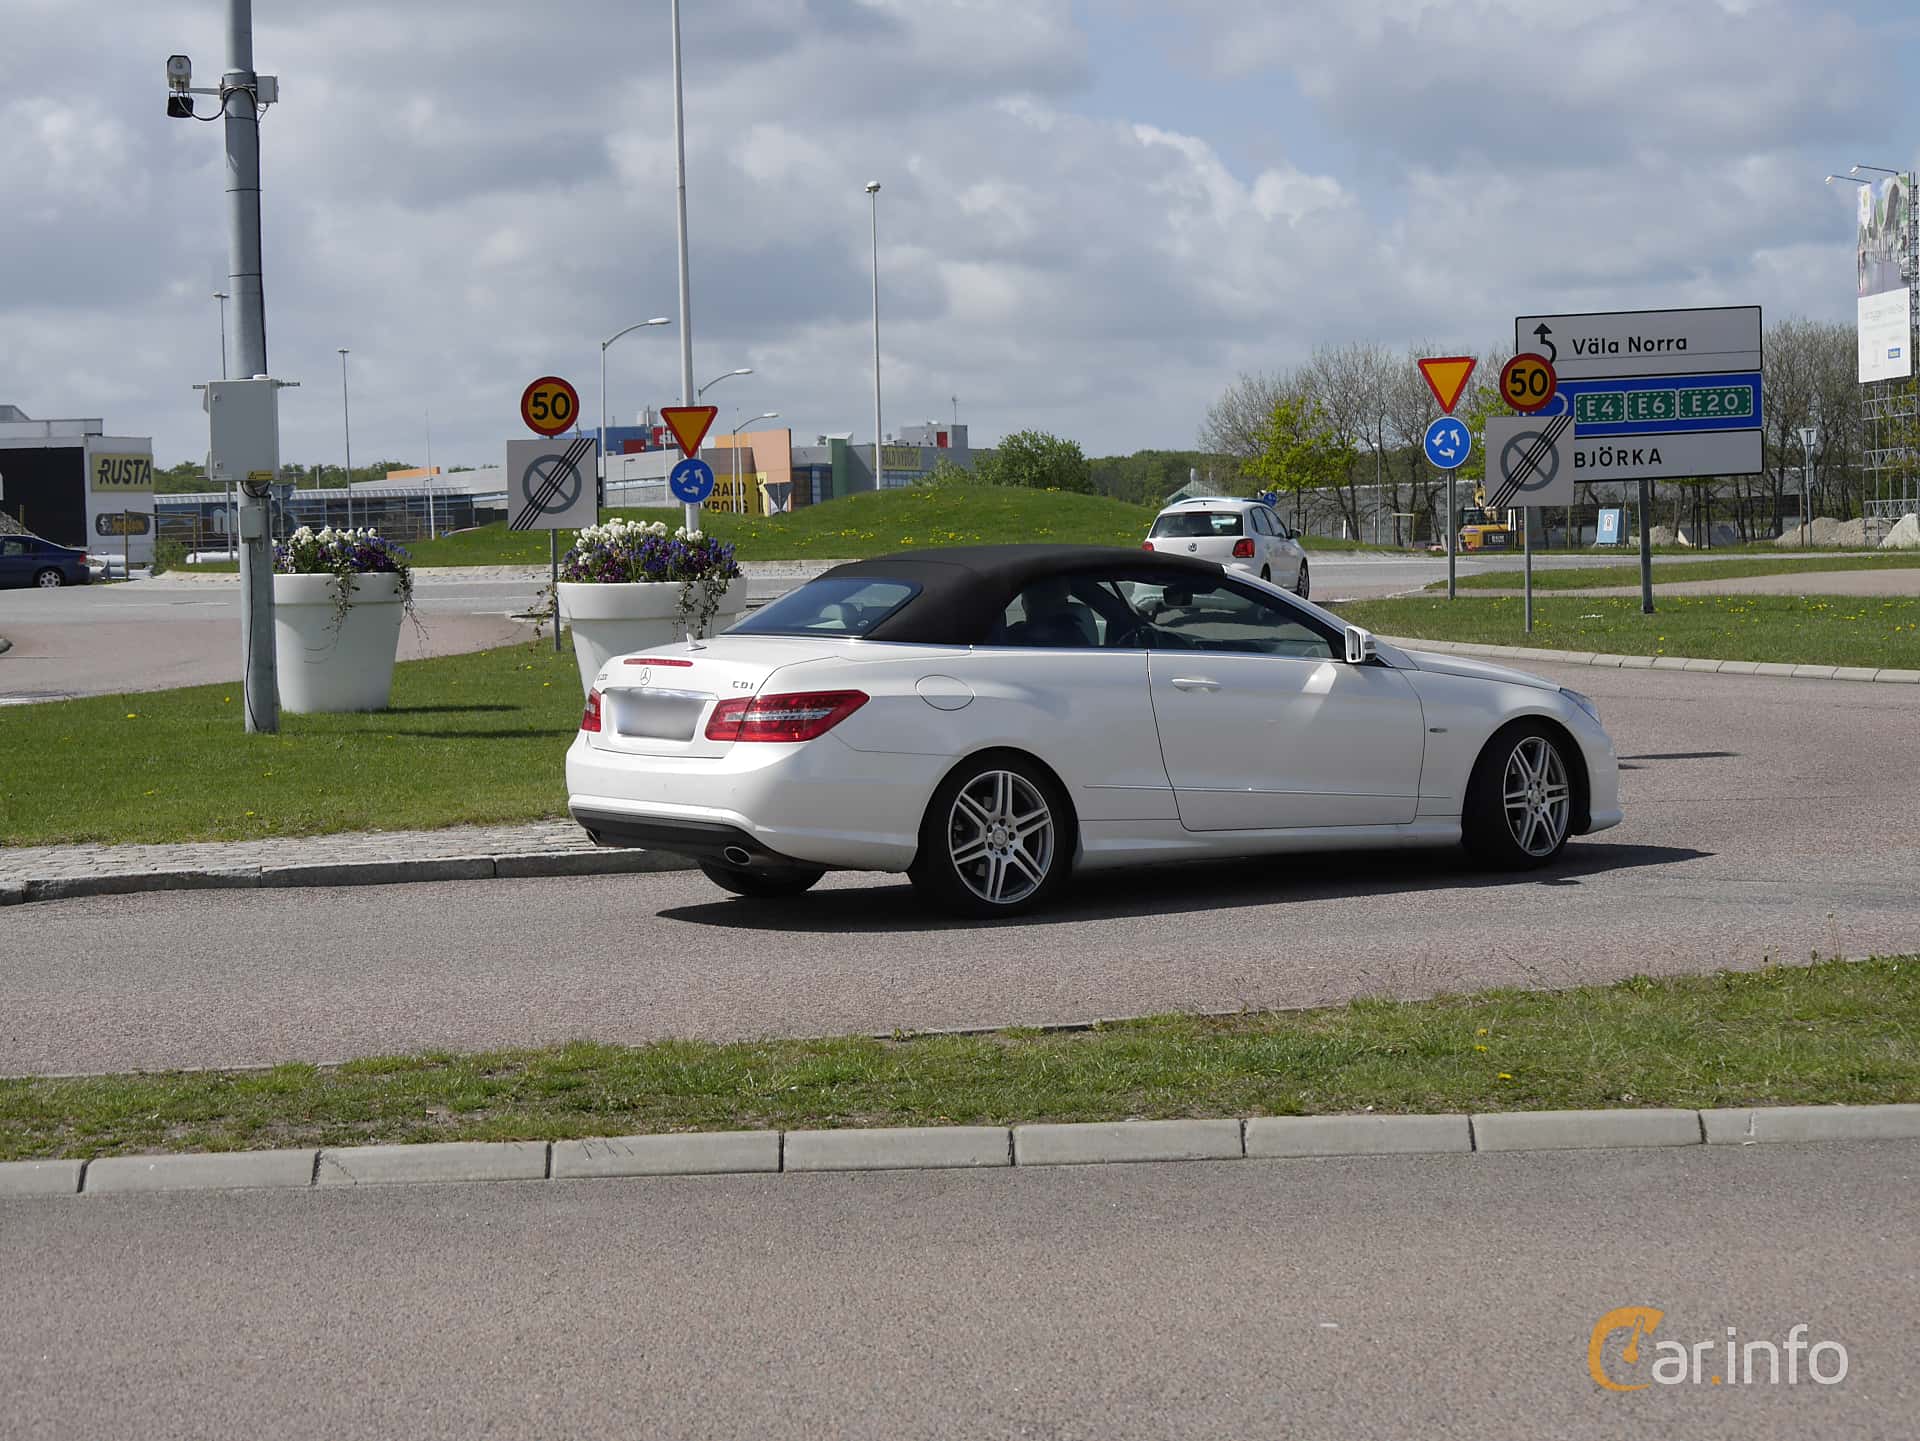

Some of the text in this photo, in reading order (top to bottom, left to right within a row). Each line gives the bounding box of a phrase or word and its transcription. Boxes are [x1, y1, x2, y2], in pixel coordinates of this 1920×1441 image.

[1572, 336, 1688, 355] Väla Norra
[1510, 368, 1549, 397] 50
[532, 391, 571, 420] 50
[1586, 393, 1739, 417] E4 E6 E20
[1574, 446, 1663, 468] BJÖRKA
[98, 458, 151, 485] RUSTA
[710, 482, 747, 497] RALD
[732, 680, 755, 690] CDI
